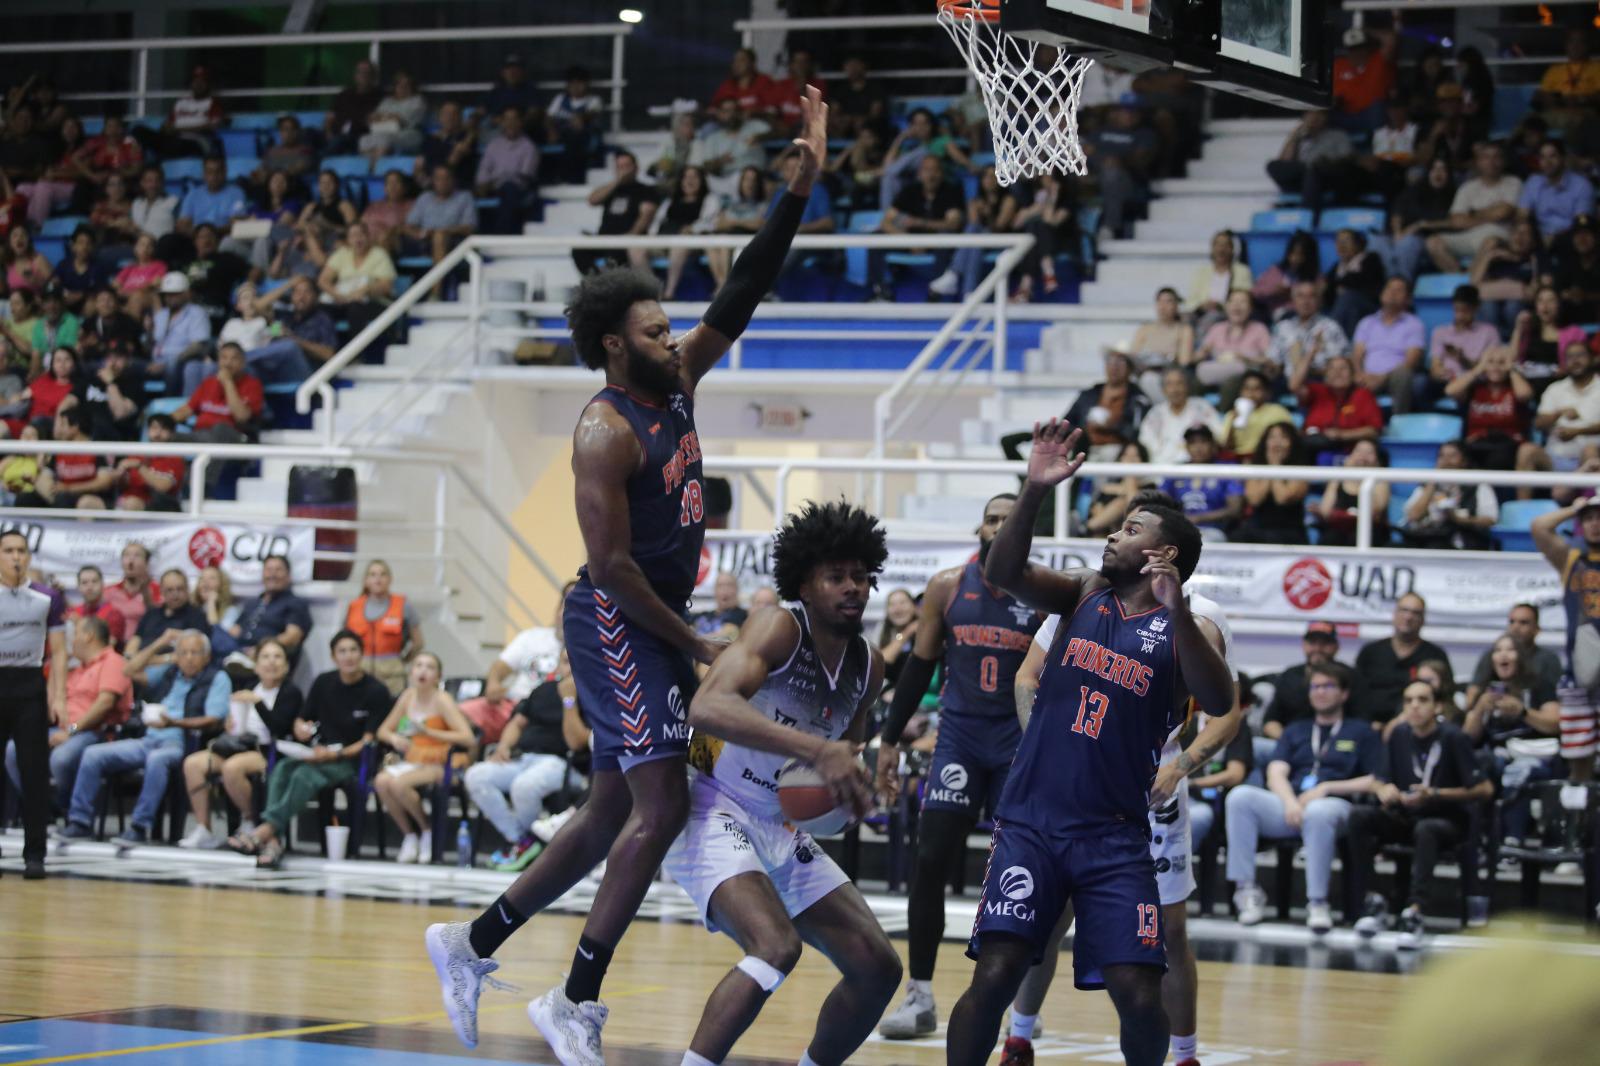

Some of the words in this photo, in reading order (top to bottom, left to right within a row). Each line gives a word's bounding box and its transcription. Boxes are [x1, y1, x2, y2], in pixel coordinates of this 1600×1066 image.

[680, 478, 704, 527] 18
[1339, 562, 1416, 600] UAD
[980, 656, 998, 692] 0
[1061, 637, 1154, 697] PIONEROS
[1071, 685, 1110, 740] 13
[984, 901, 1035, 922] MEGA
[1136, 903, 1158, 938] 13
